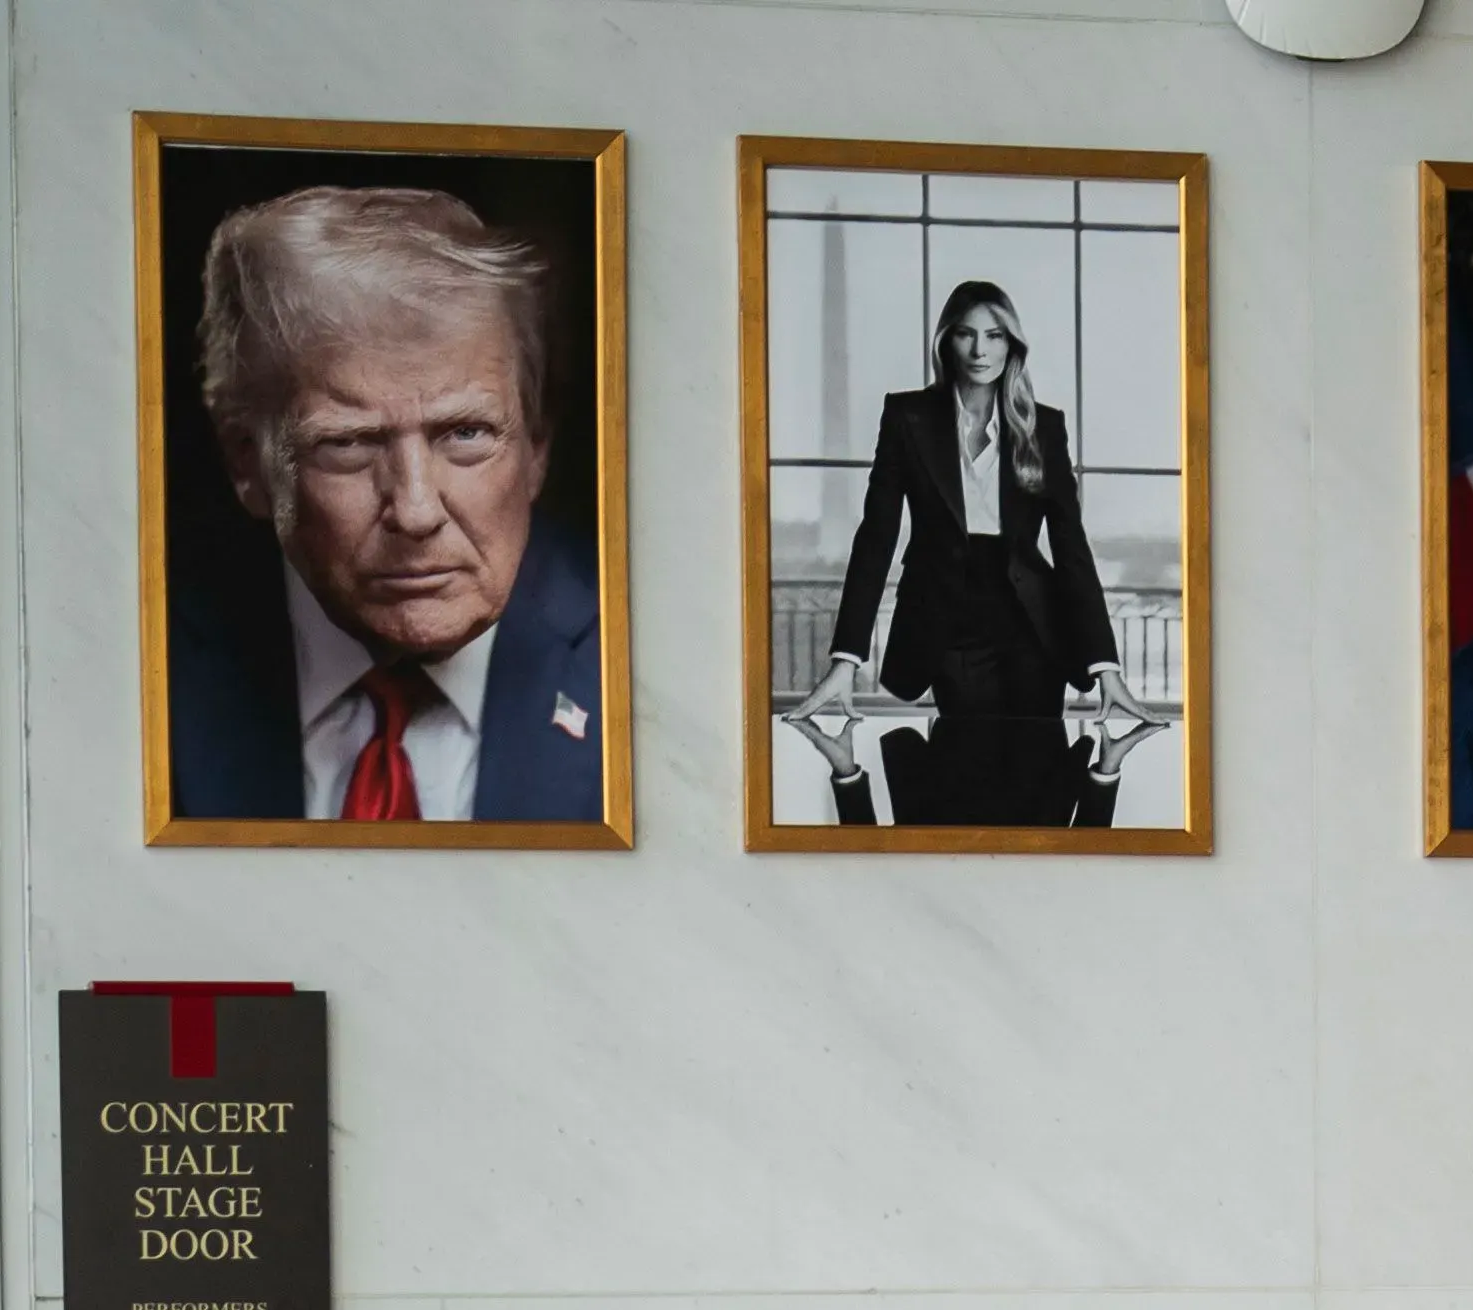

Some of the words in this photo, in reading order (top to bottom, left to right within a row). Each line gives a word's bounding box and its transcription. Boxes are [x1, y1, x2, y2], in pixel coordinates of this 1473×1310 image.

[100, 1102, 293, 1134] CONCERT
[142, 1145, 253, 1175] HALL
[134, 1187, 262, 1218] STAGE
[139, 1229, 258, 1261] DOOR
